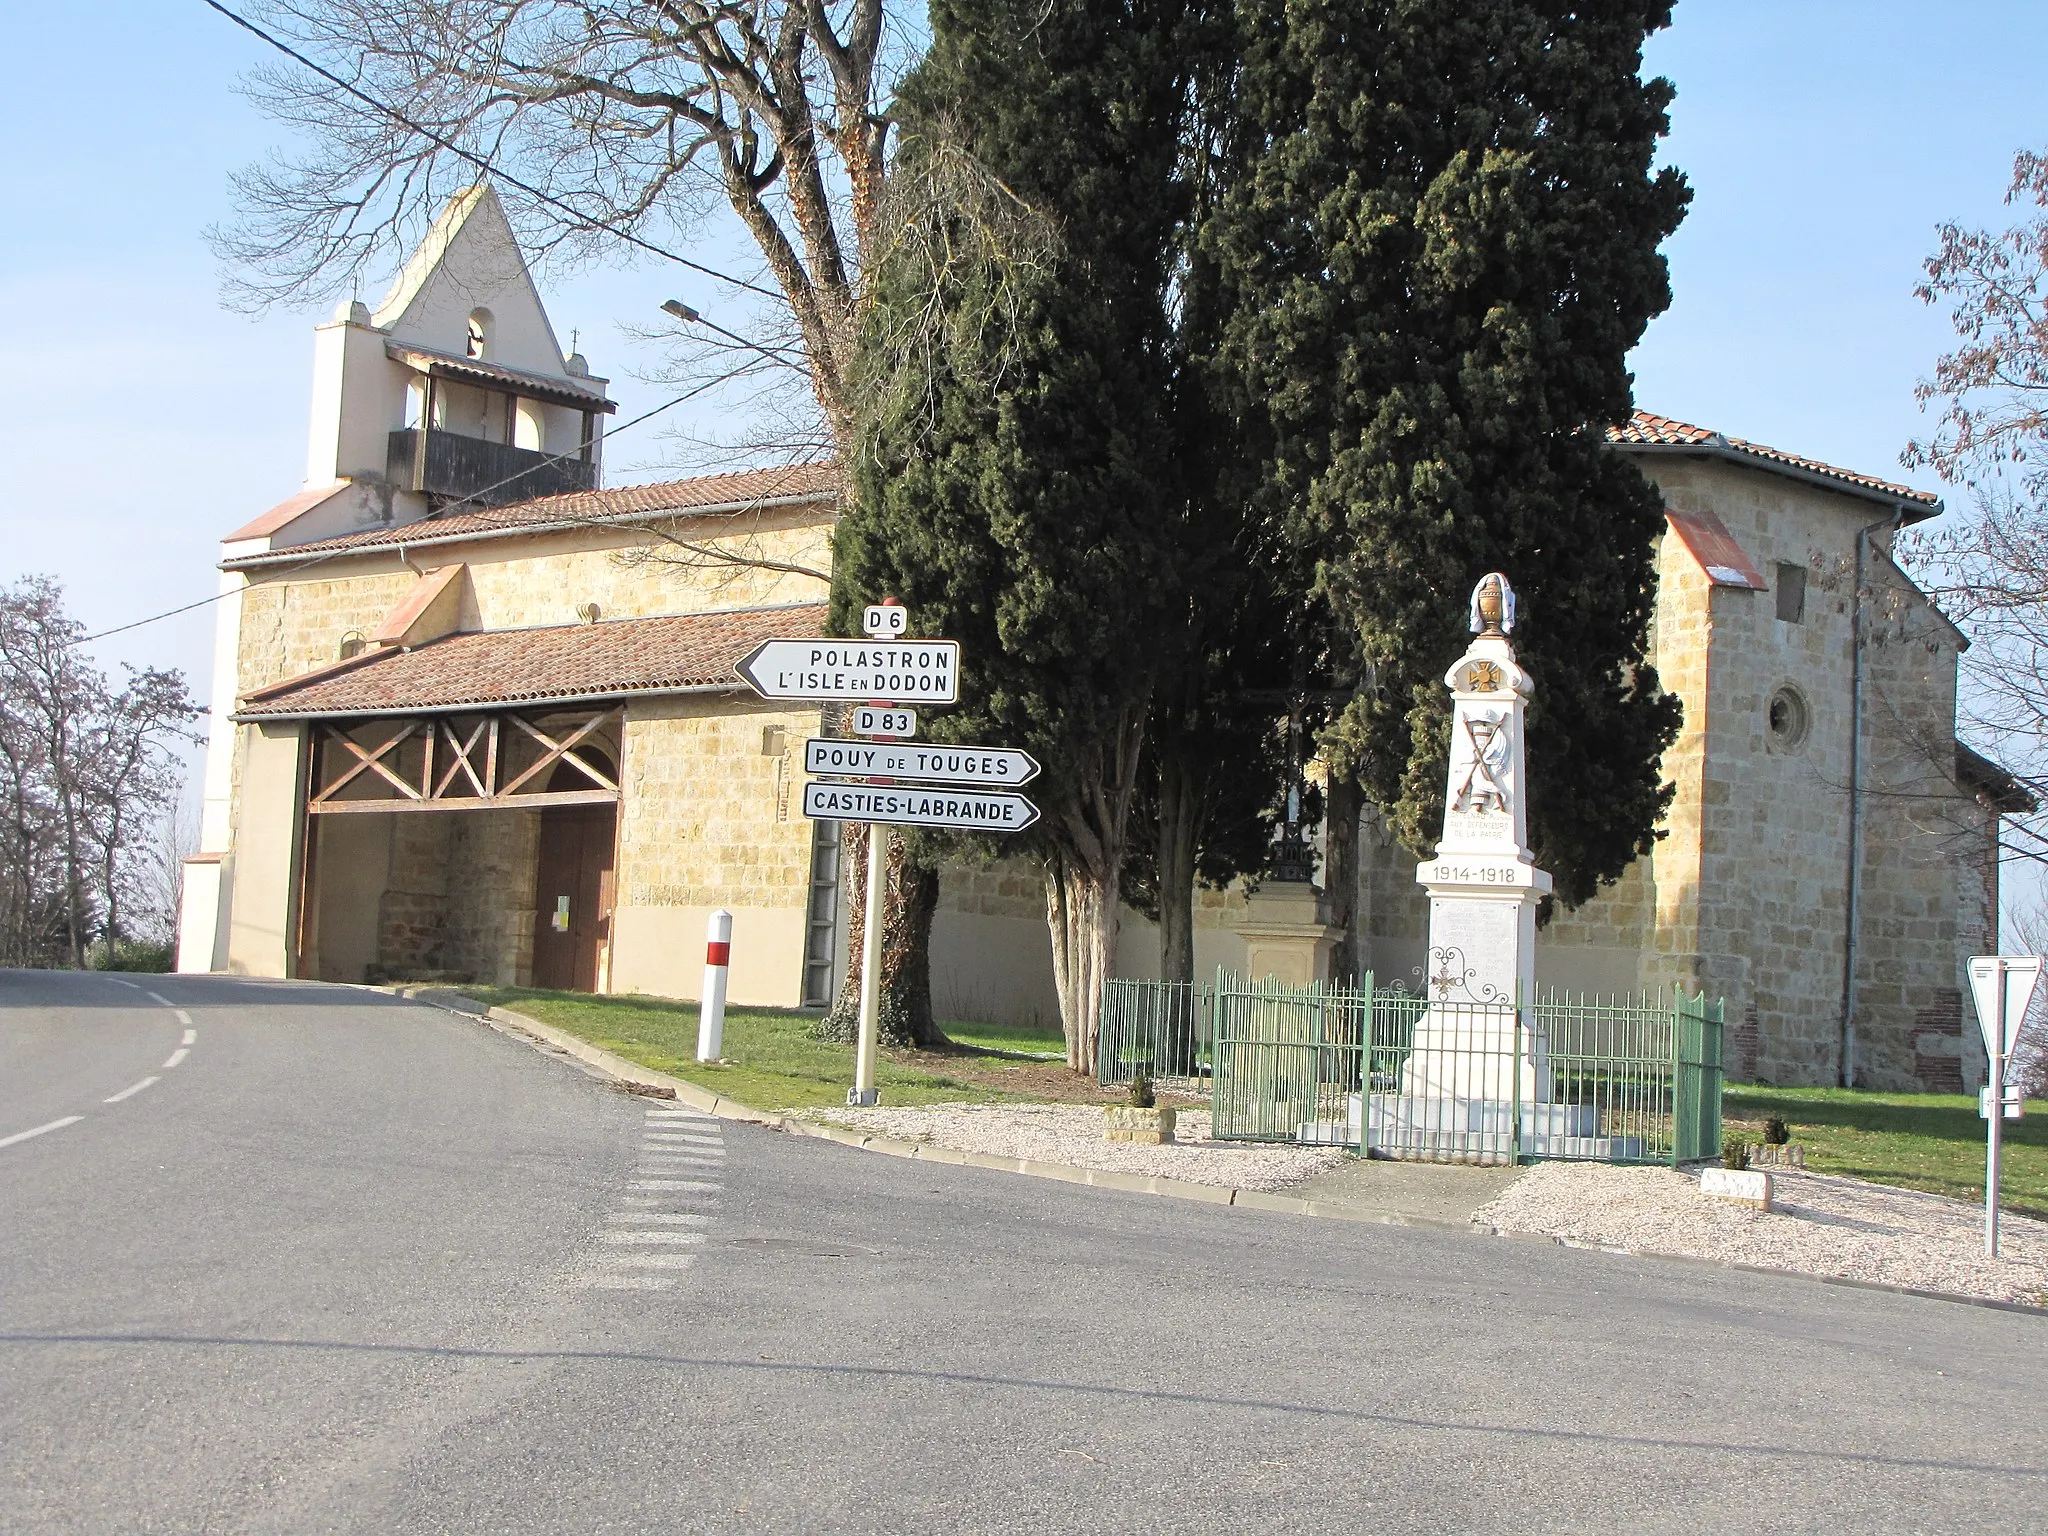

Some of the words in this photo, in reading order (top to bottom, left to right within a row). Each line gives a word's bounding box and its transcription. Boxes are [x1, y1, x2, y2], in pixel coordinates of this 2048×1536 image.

[869, 611, 881, 628] D
[889, 611, 901, 628] 6
[810, 650, 948, 669] POLASTRON
[778, 672, 845, 690] L'ISLE
[851, 679, 868, 690] EN
[874, 674, 947, 692] DODON
[861, 712, 874, 729] D
[882, 713, 908, 731] 83
[815, 748, 876, 768] POUY
[886, 758, 905, 770] DE
[917, 754, 1008, 775] TOUGES
[813, 792, 1014, 821] CASTIES-LABRANDE
[1433, 866, 1515, 883] 1914-1918
